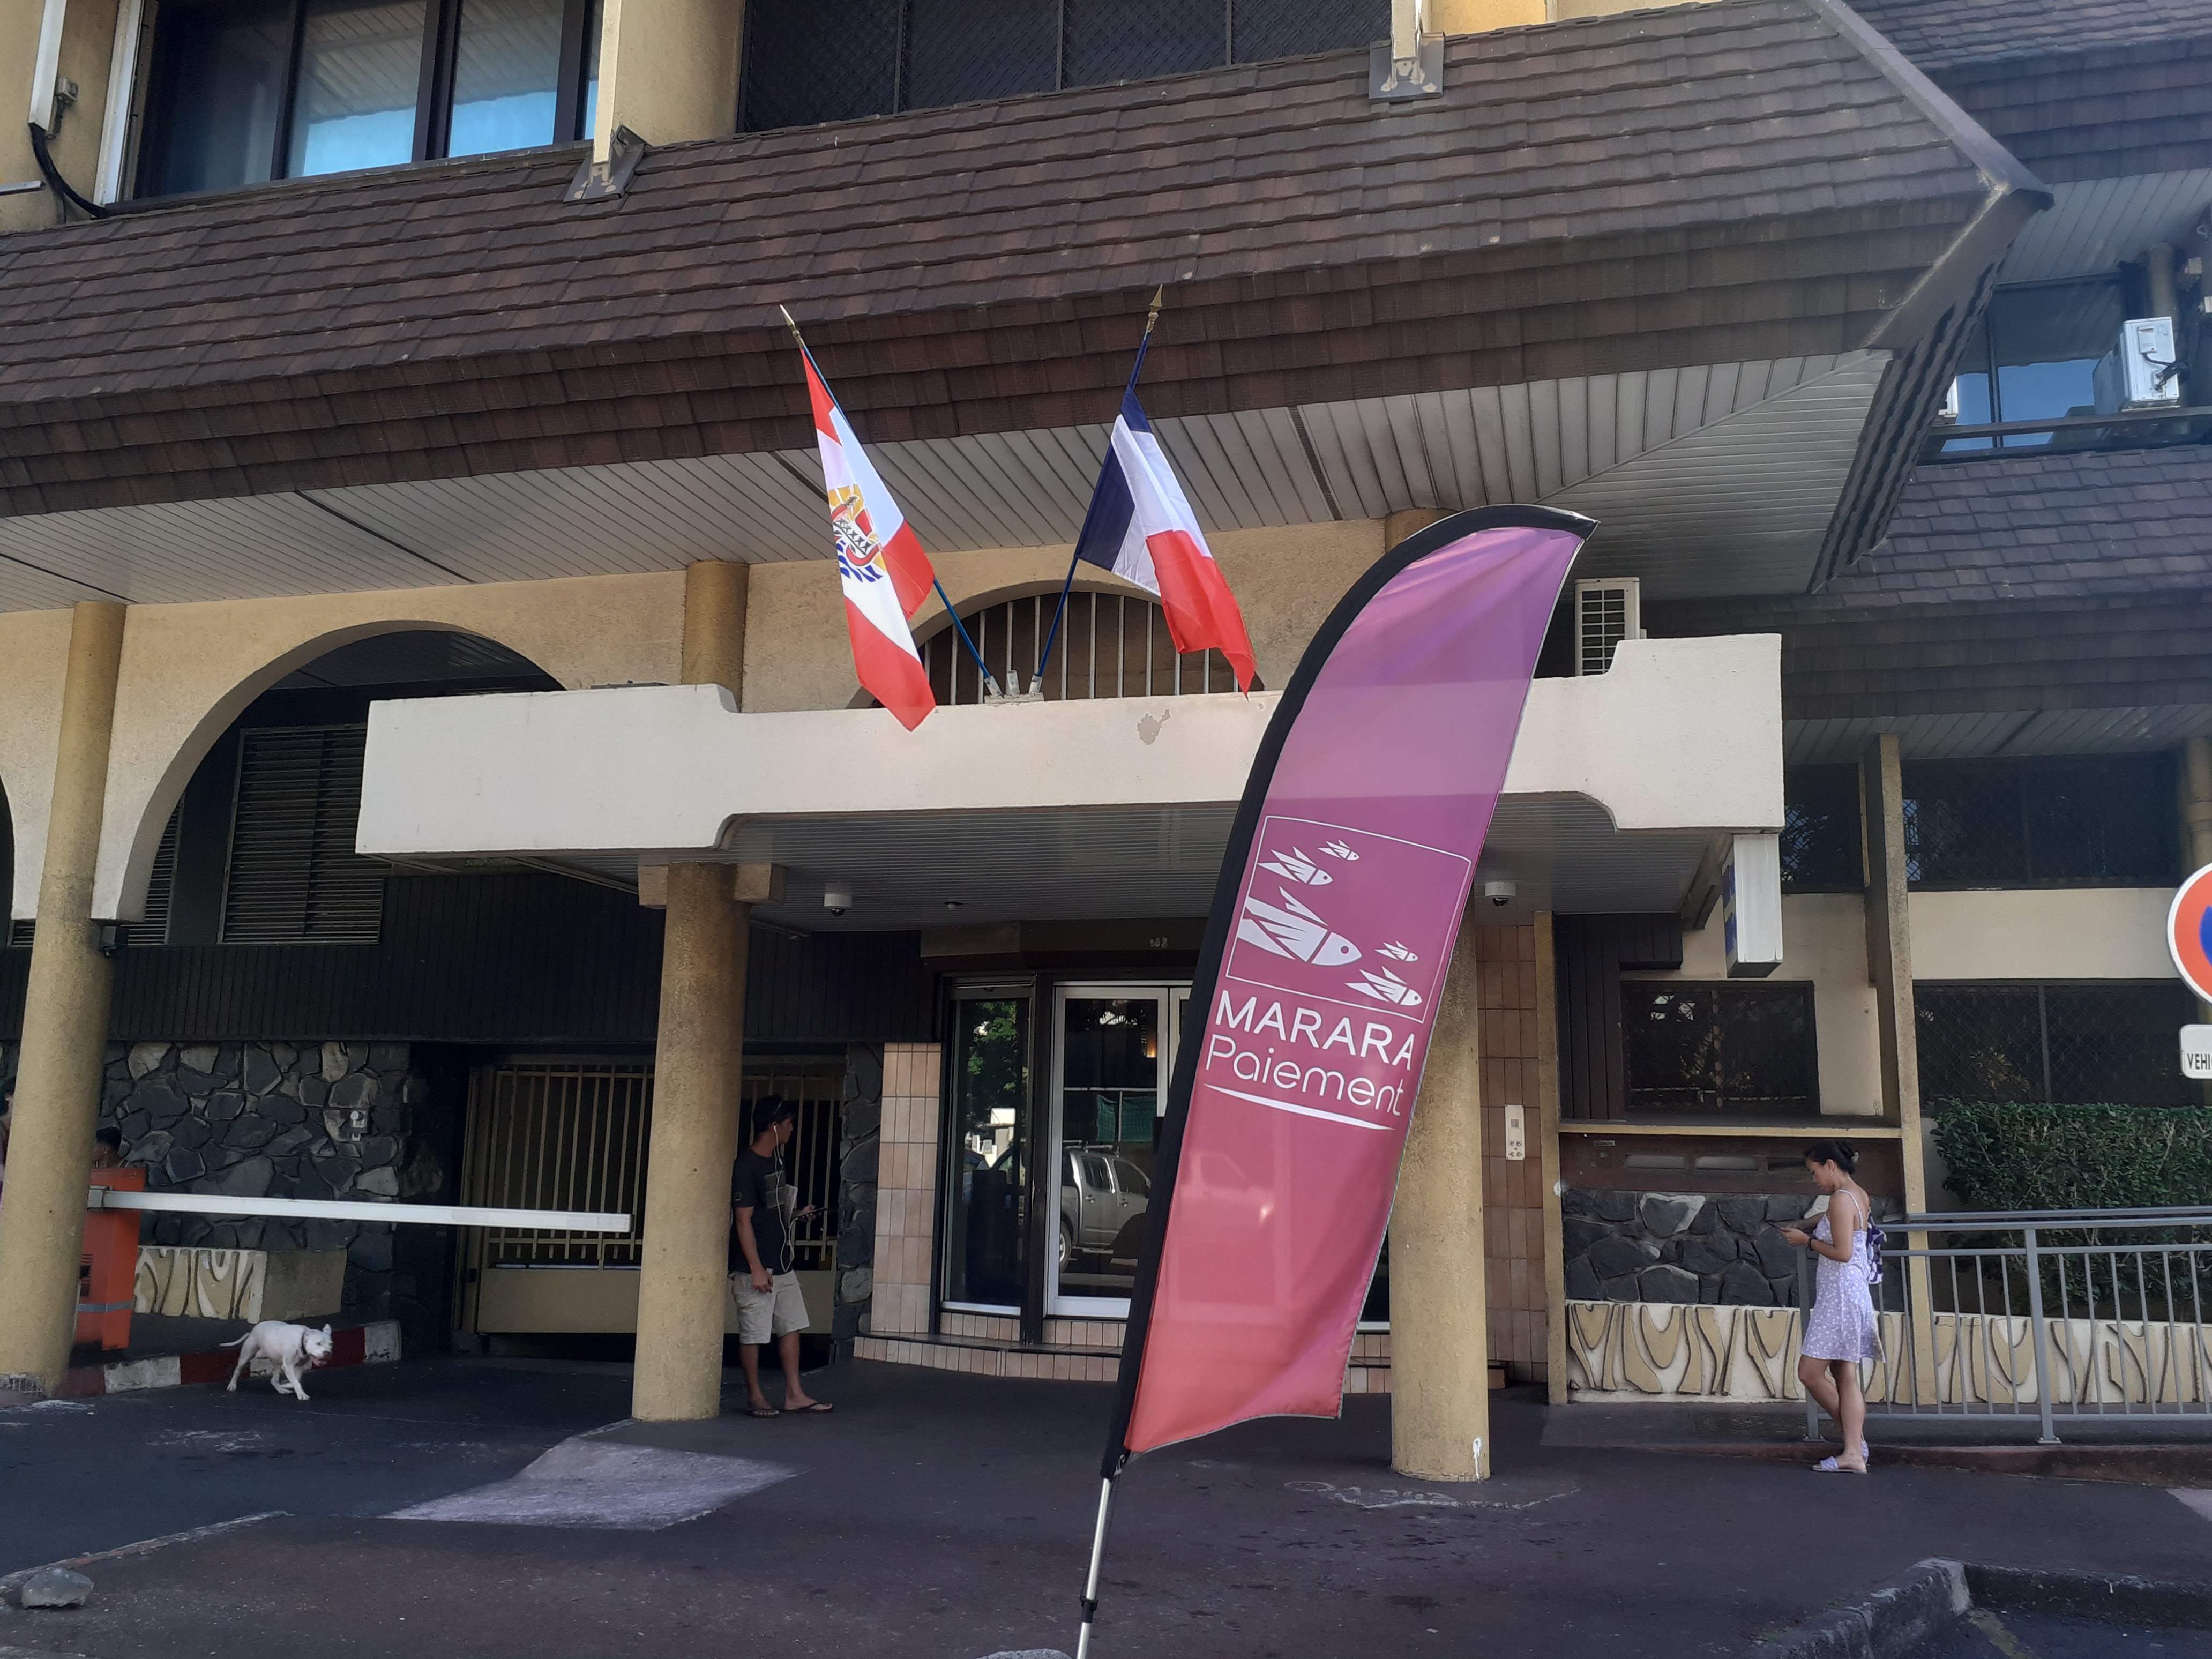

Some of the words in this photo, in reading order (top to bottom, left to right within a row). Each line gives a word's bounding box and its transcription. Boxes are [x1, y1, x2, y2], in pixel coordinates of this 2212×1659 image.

[1215, 990, 1415, 1070] MARARA
[2187, 1053, 2212, 1070] VEHI
[1206, 1033, 1404, 1116] Paiement
